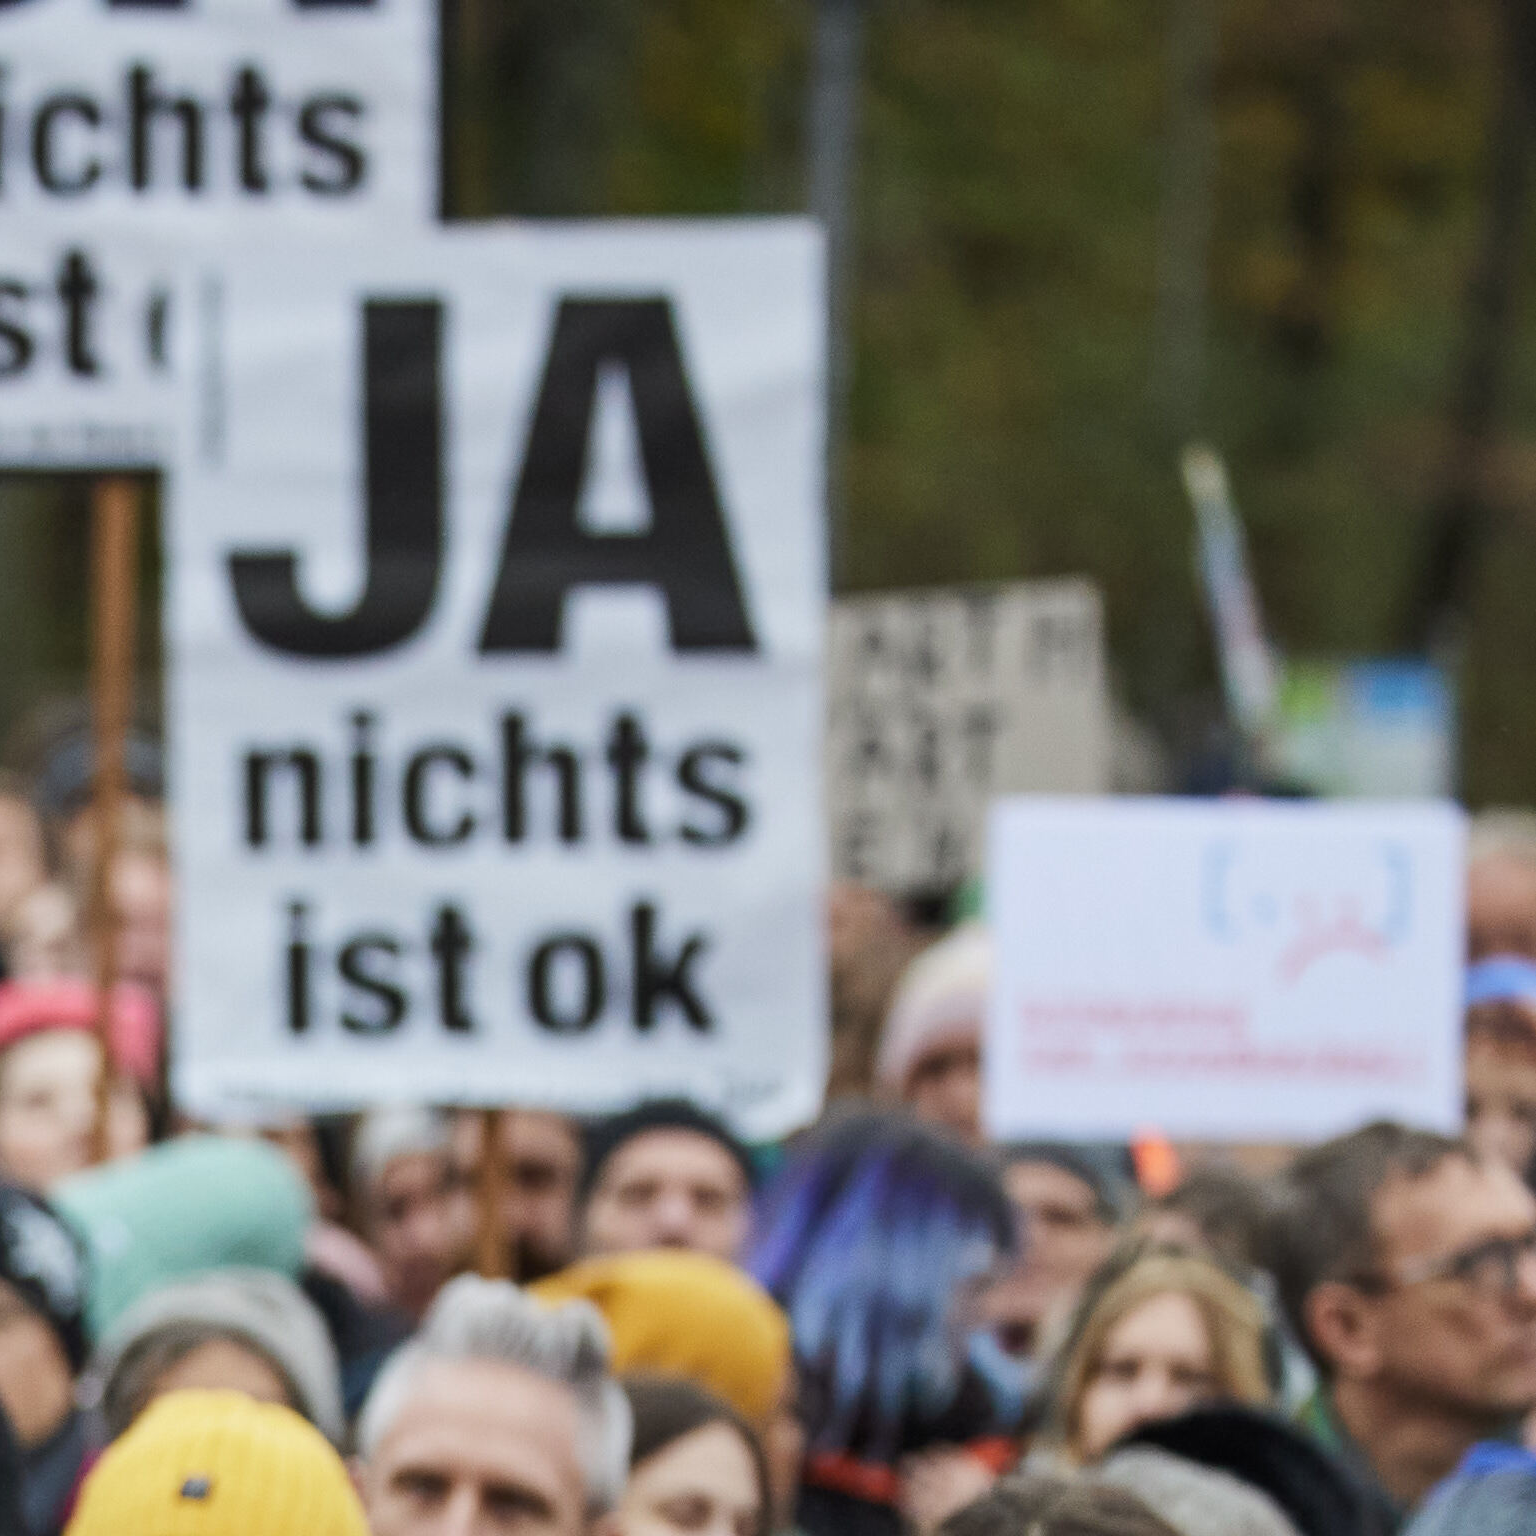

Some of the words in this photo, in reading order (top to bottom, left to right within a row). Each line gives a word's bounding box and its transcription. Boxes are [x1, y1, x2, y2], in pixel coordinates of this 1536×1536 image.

[227, 293, 760, 660] JA
[243, 711, 750, 848] nichts
[284, 900, 476, 1034] ist
[527, 900, 716, 1034] ok
